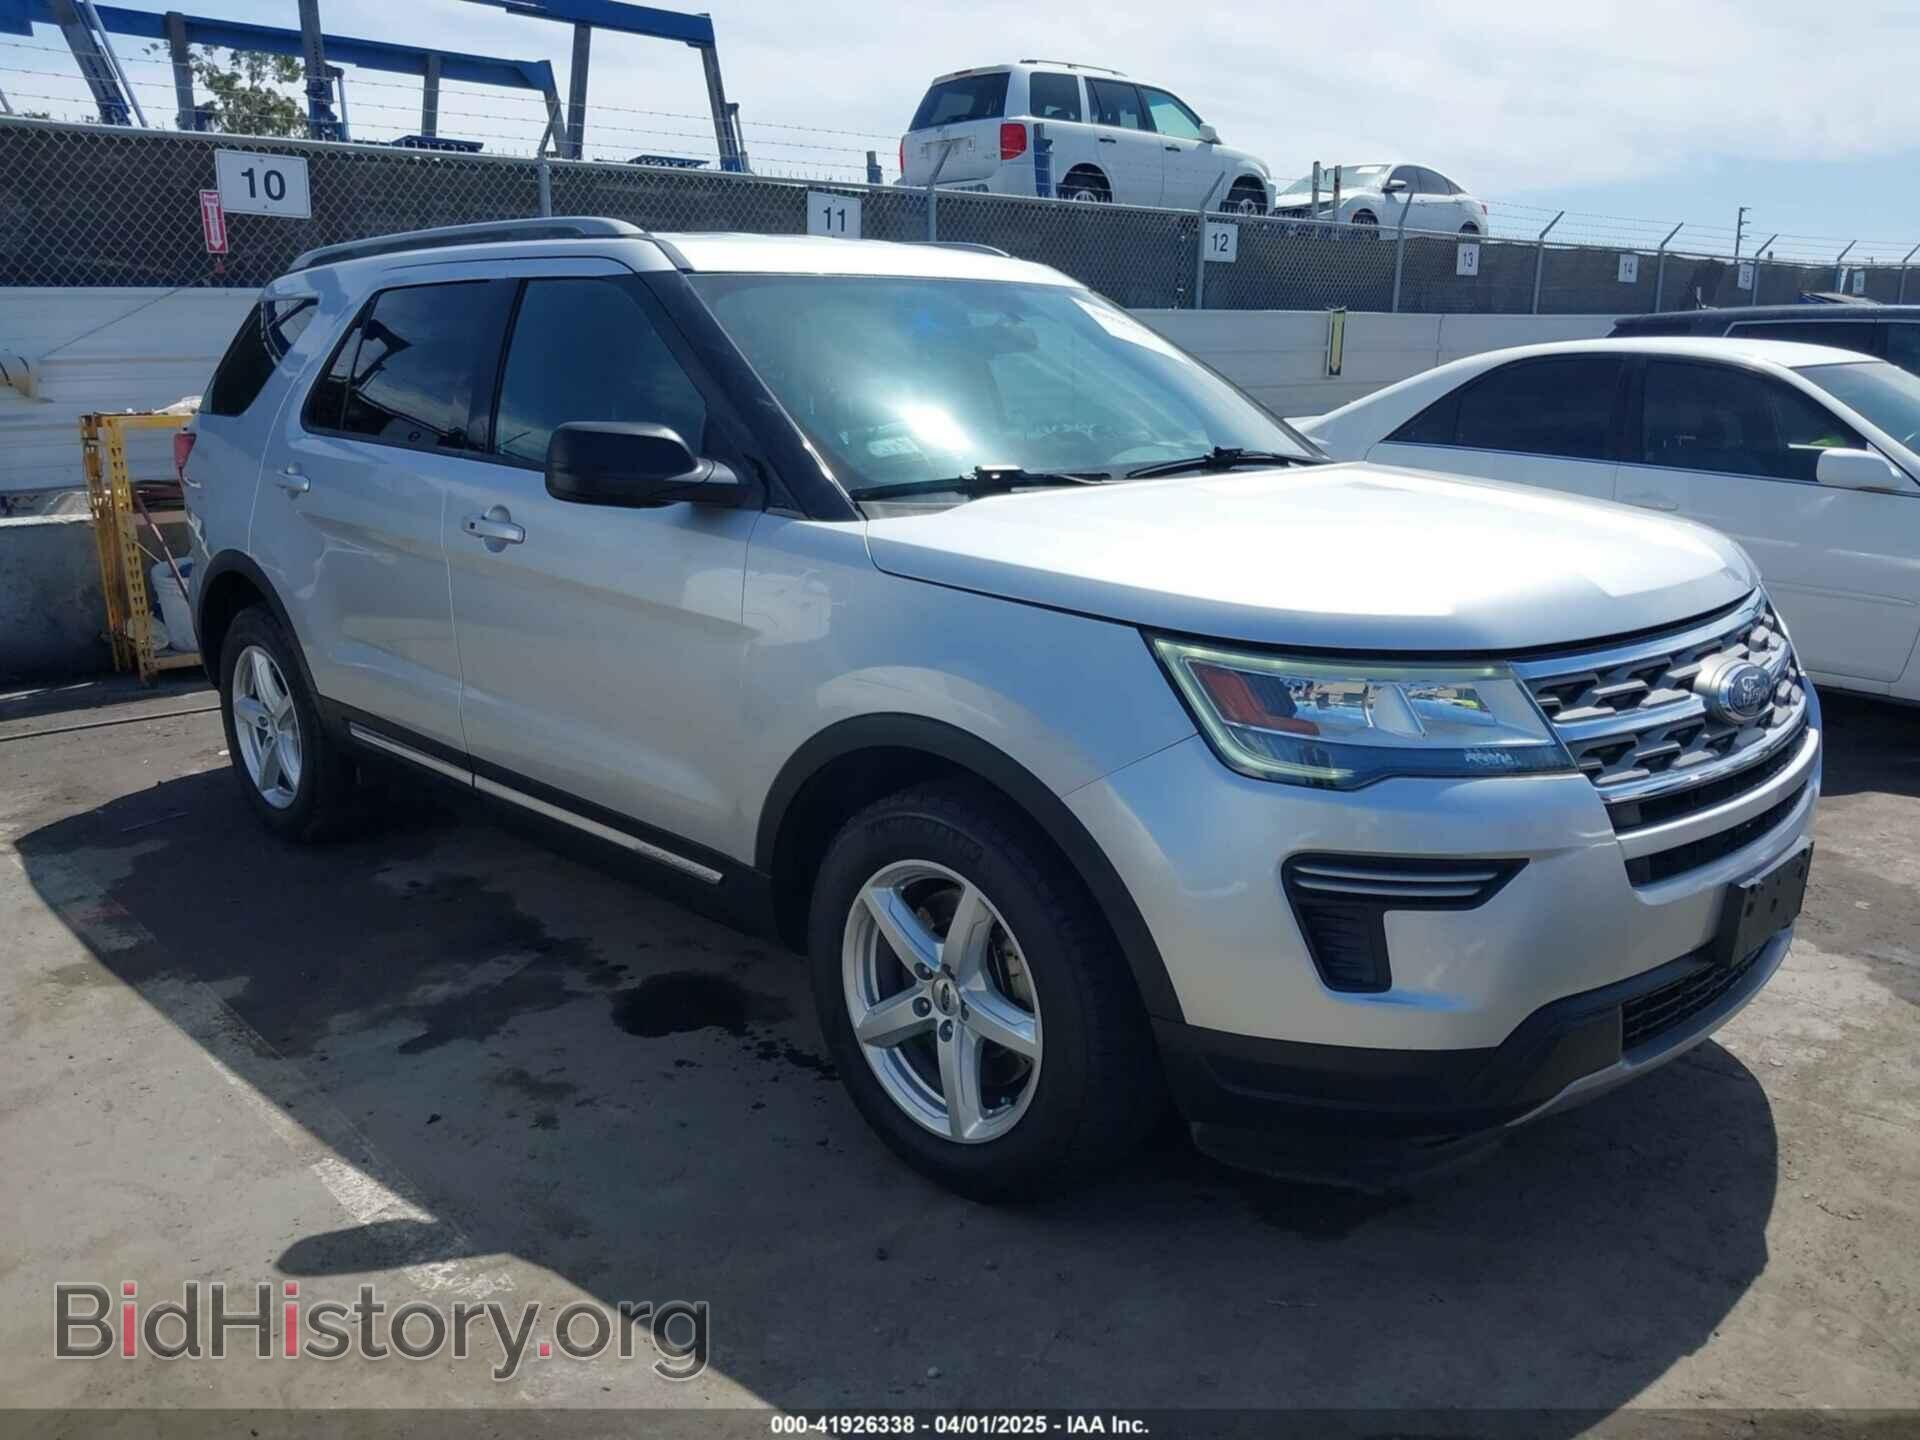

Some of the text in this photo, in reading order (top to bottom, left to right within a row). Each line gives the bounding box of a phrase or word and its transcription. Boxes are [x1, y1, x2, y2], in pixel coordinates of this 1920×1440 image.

[241, 168, 286, 201] 10
[823, 207, 846, 233] 11
[1211, 232, 1229, 252] 12
[1463, 251, 1474, 267] 13
